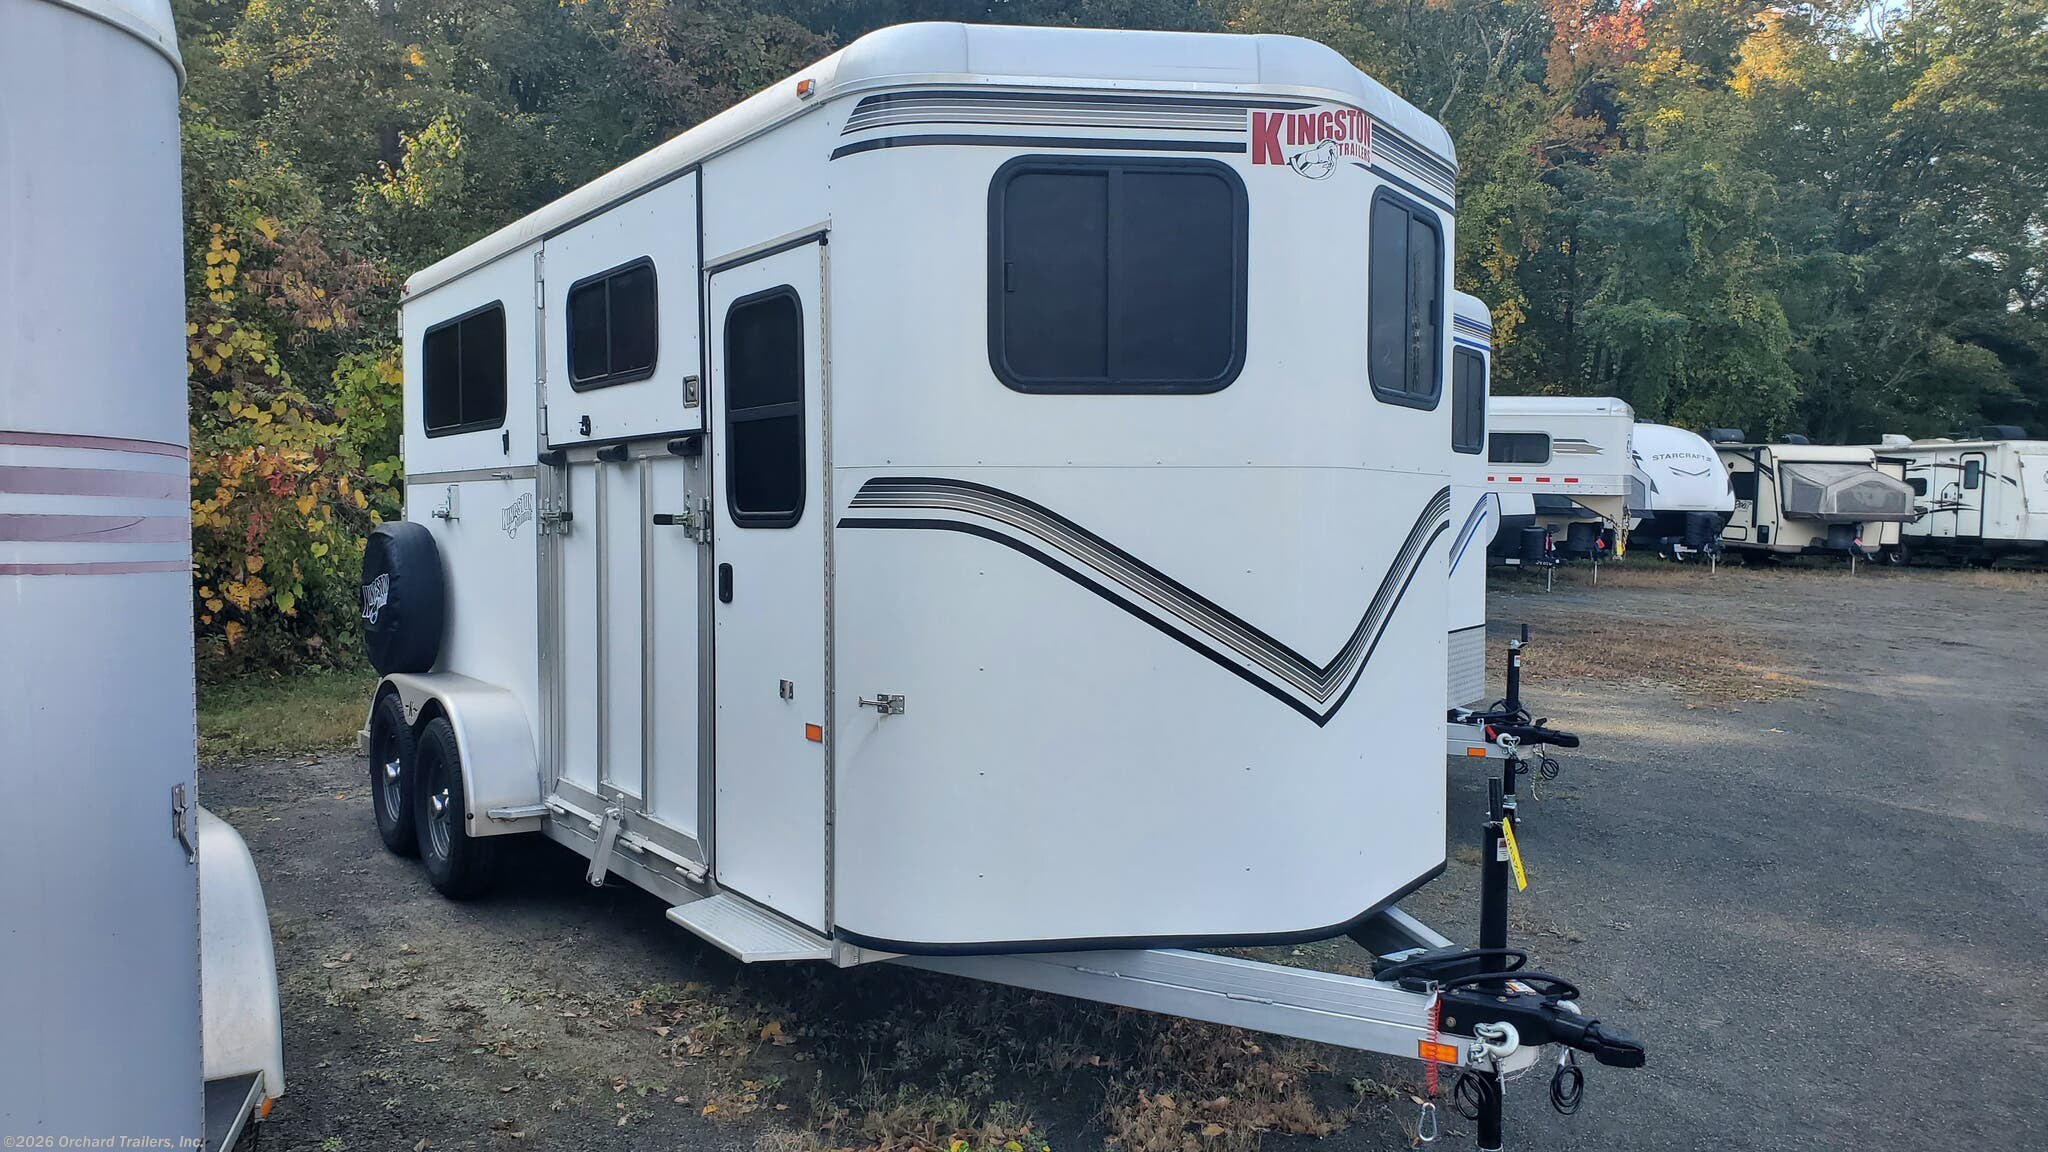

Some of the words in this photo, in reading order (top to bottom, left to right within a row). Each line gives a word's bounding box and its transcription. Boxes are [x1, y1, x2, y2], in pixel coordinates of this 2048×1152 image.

[1252, 110, 1371, 165] KINGSTON
[1338, 142, 1371, 163] TRAILERS
[1652, 452, 1705, 461] STARCRAFT
